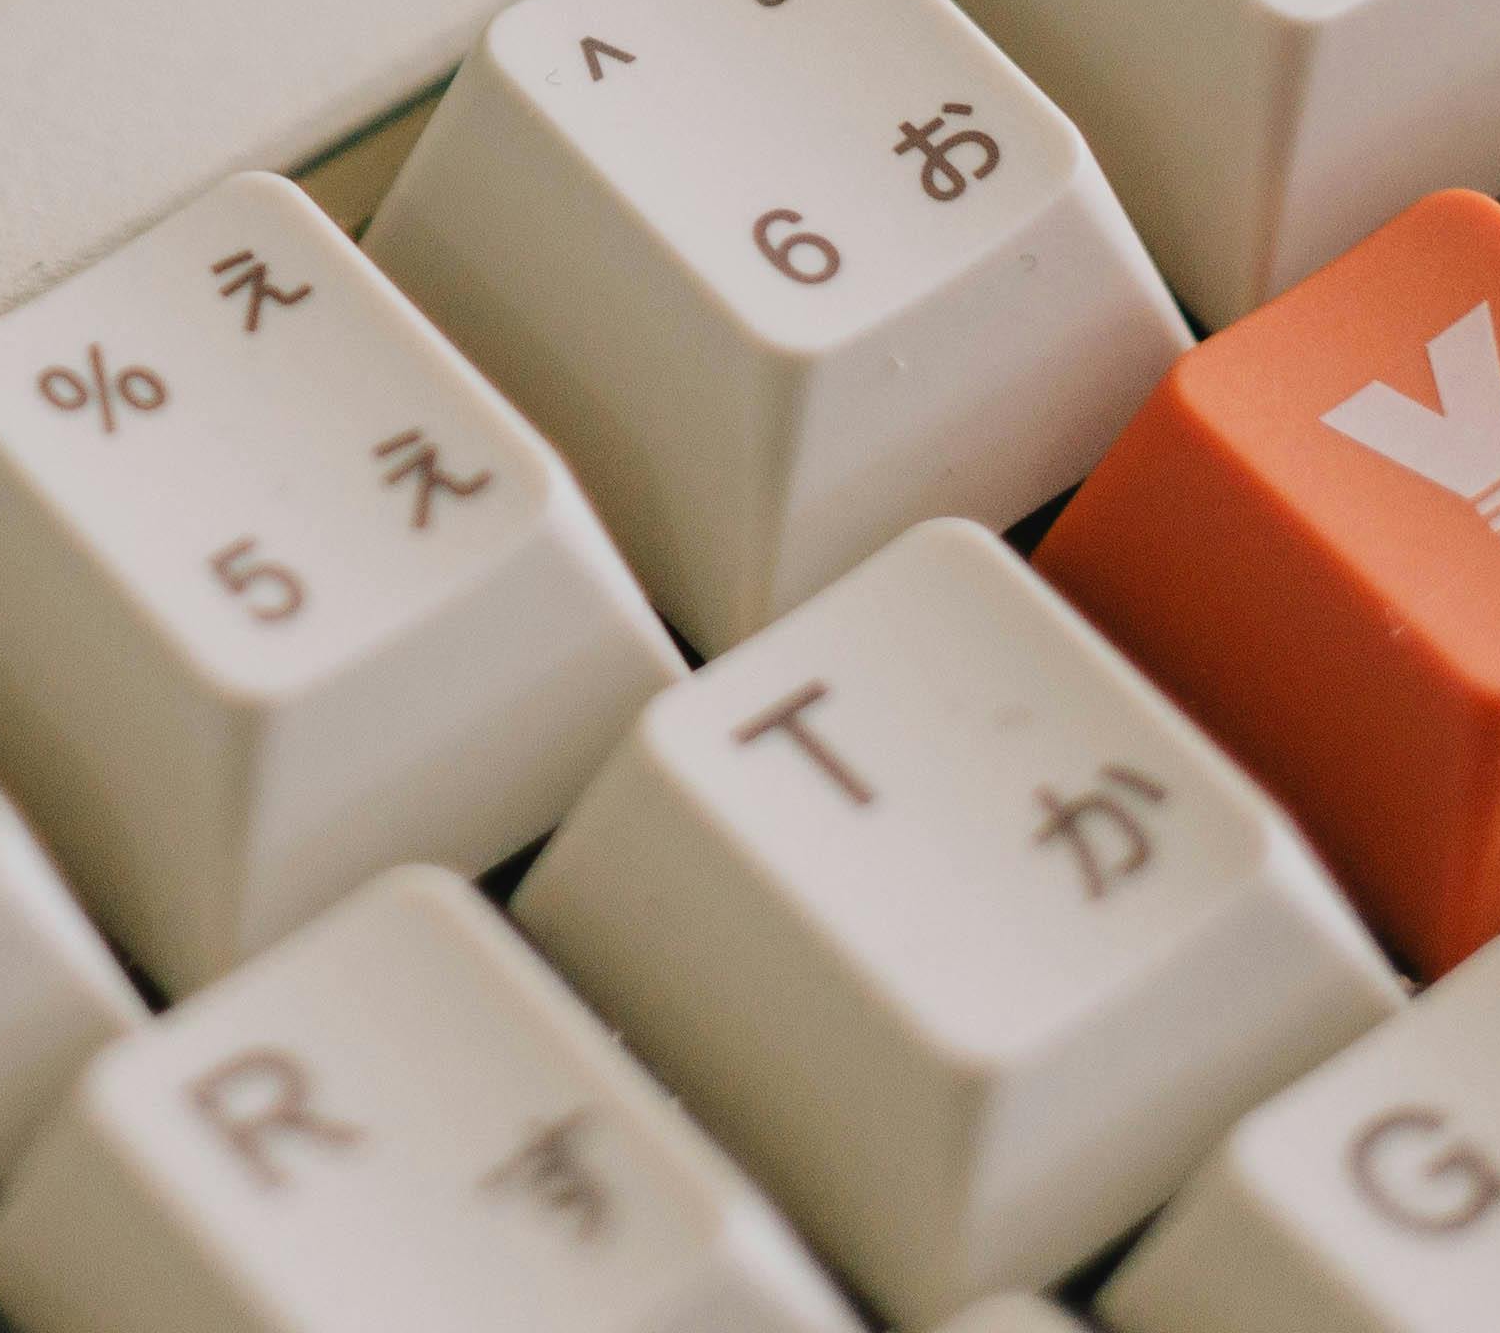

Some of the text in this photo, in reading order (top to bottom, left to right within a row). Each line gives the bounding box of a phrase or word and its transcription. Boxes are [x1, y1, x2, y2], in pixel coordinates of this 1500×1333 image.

[893, 102, 1001, 203] お
[751, 207, 842, 285] 6
[36, 341, 169, 434] %
[374, 428, 492, 530] え
[211, 538, 306, 625] 5
[733, 679, 876, 807] T
[188, 1047, 367, 1193] R
